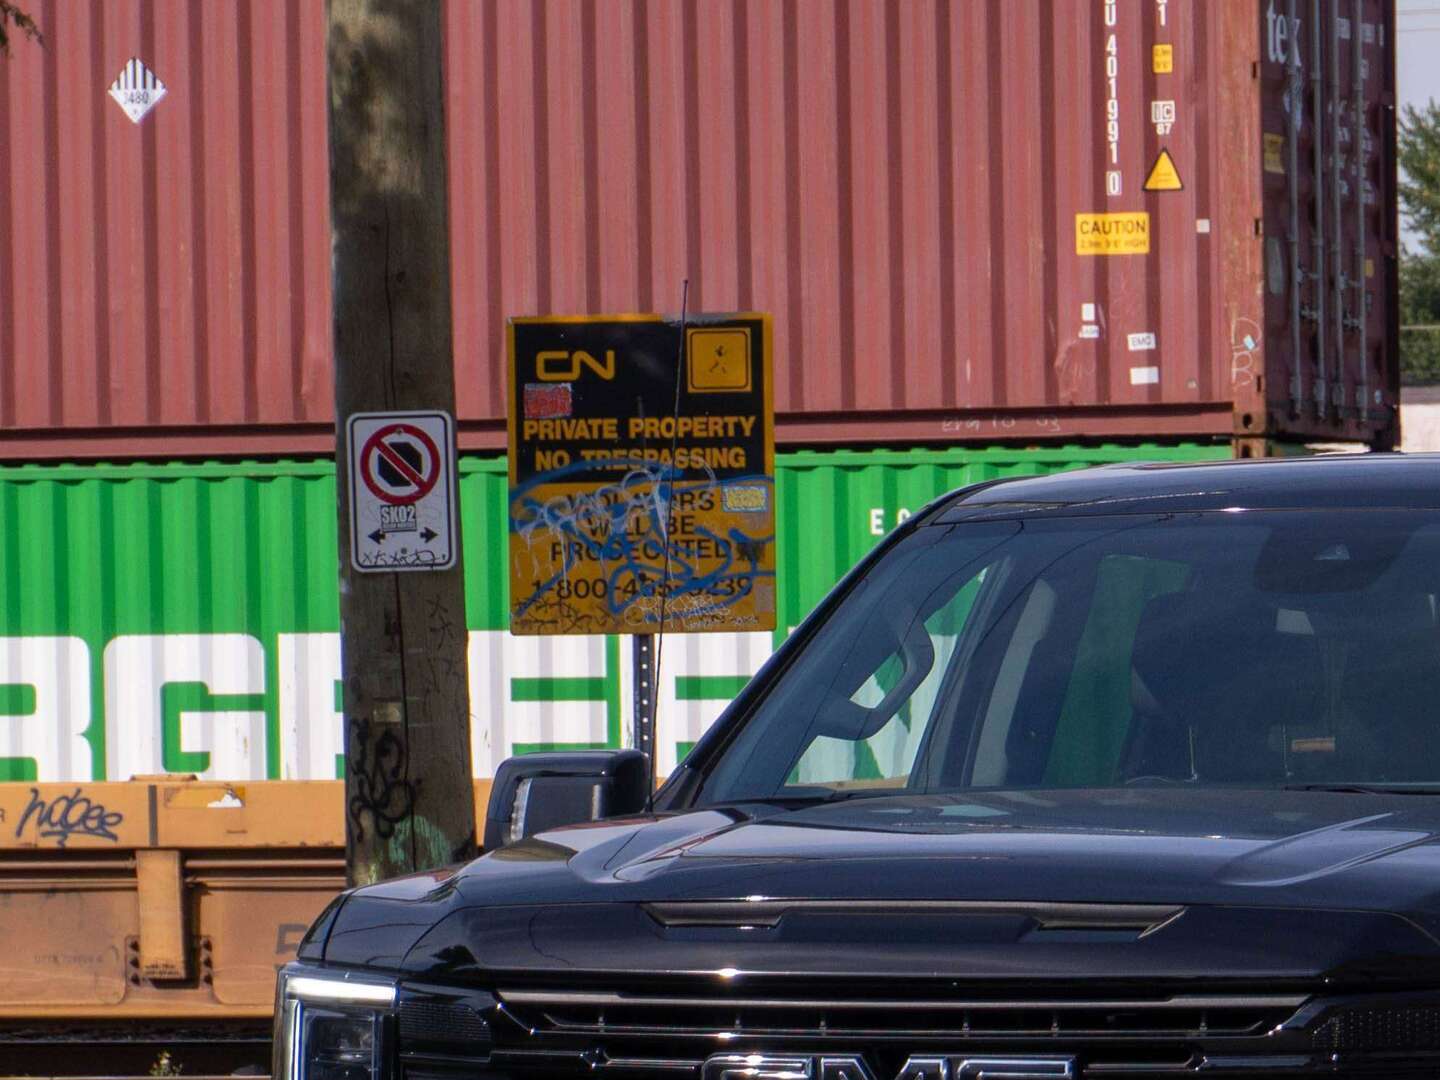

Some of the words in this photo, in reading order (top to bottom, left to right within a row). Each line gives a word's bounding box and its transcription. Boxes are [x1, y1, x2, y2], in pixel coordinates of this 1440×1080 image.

[1080, 220, 1146, 235] CAUTION
[536, 350, 615, 380] CN
[523, 419, 618, 440] PRIVATE
[629, 416, 756, 438] PROPERTY
[535, 449, 569, 471] NO
[581, 446, 746, 470] TRESPASSING
